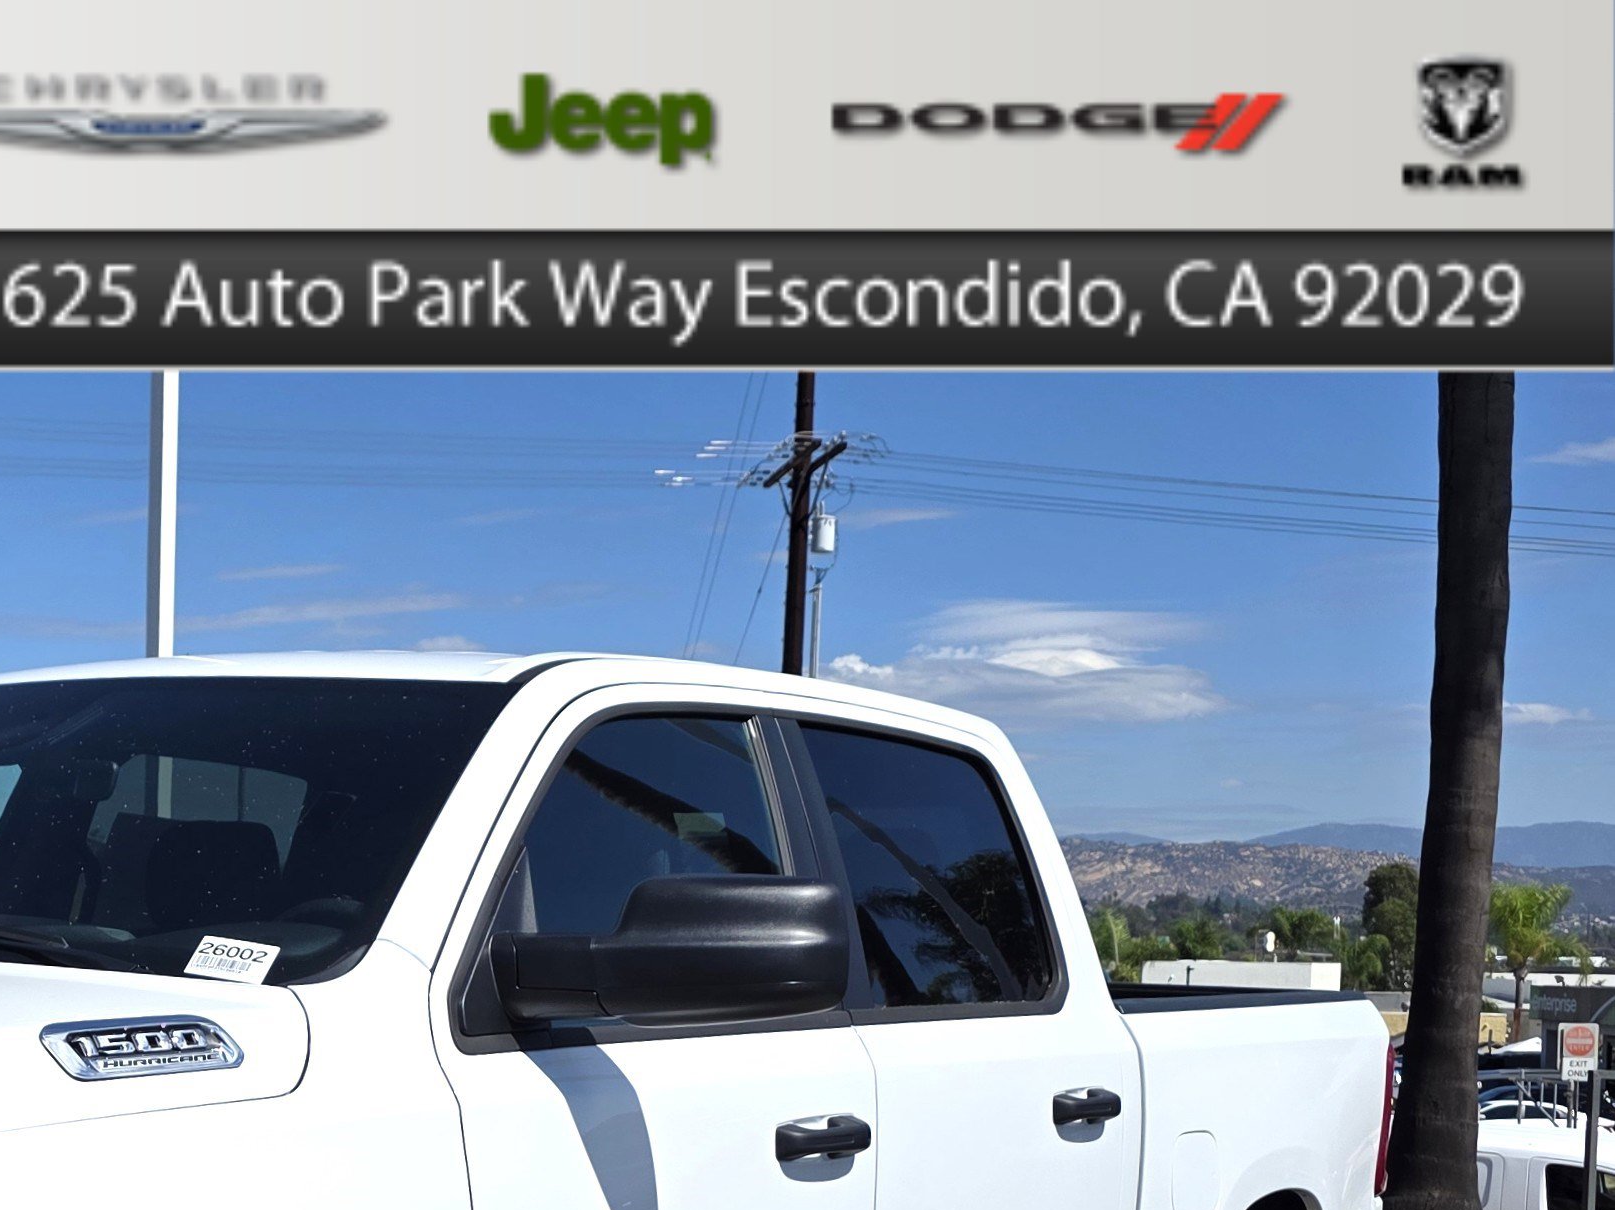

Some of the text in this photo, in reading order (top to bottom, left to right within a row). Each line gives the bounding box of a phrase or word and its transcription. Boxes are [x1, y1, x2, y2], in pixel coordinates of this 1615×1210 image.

[198, 942, 268, 963] 26002
[75, 1029, 207, 1058] 1500
[103, 1053, 220, 1068] HURRICANE
